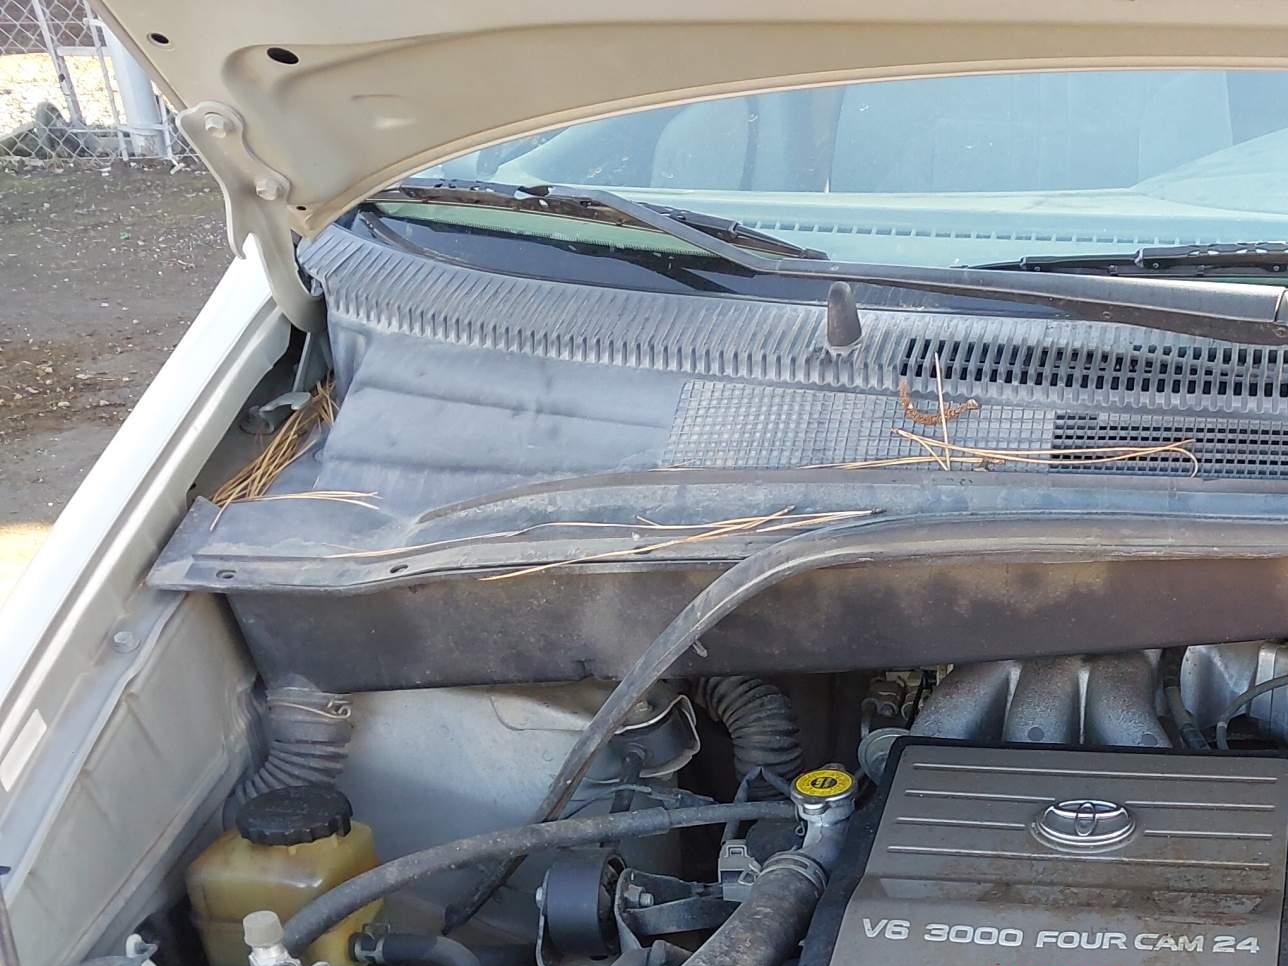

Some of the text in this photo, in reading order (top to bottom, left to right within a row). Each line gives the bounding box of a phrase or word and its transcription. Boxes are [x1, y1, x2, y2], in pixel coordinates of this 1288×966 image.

[862, 918, 1260, 953] V6 3000 FOUR CAM 24
